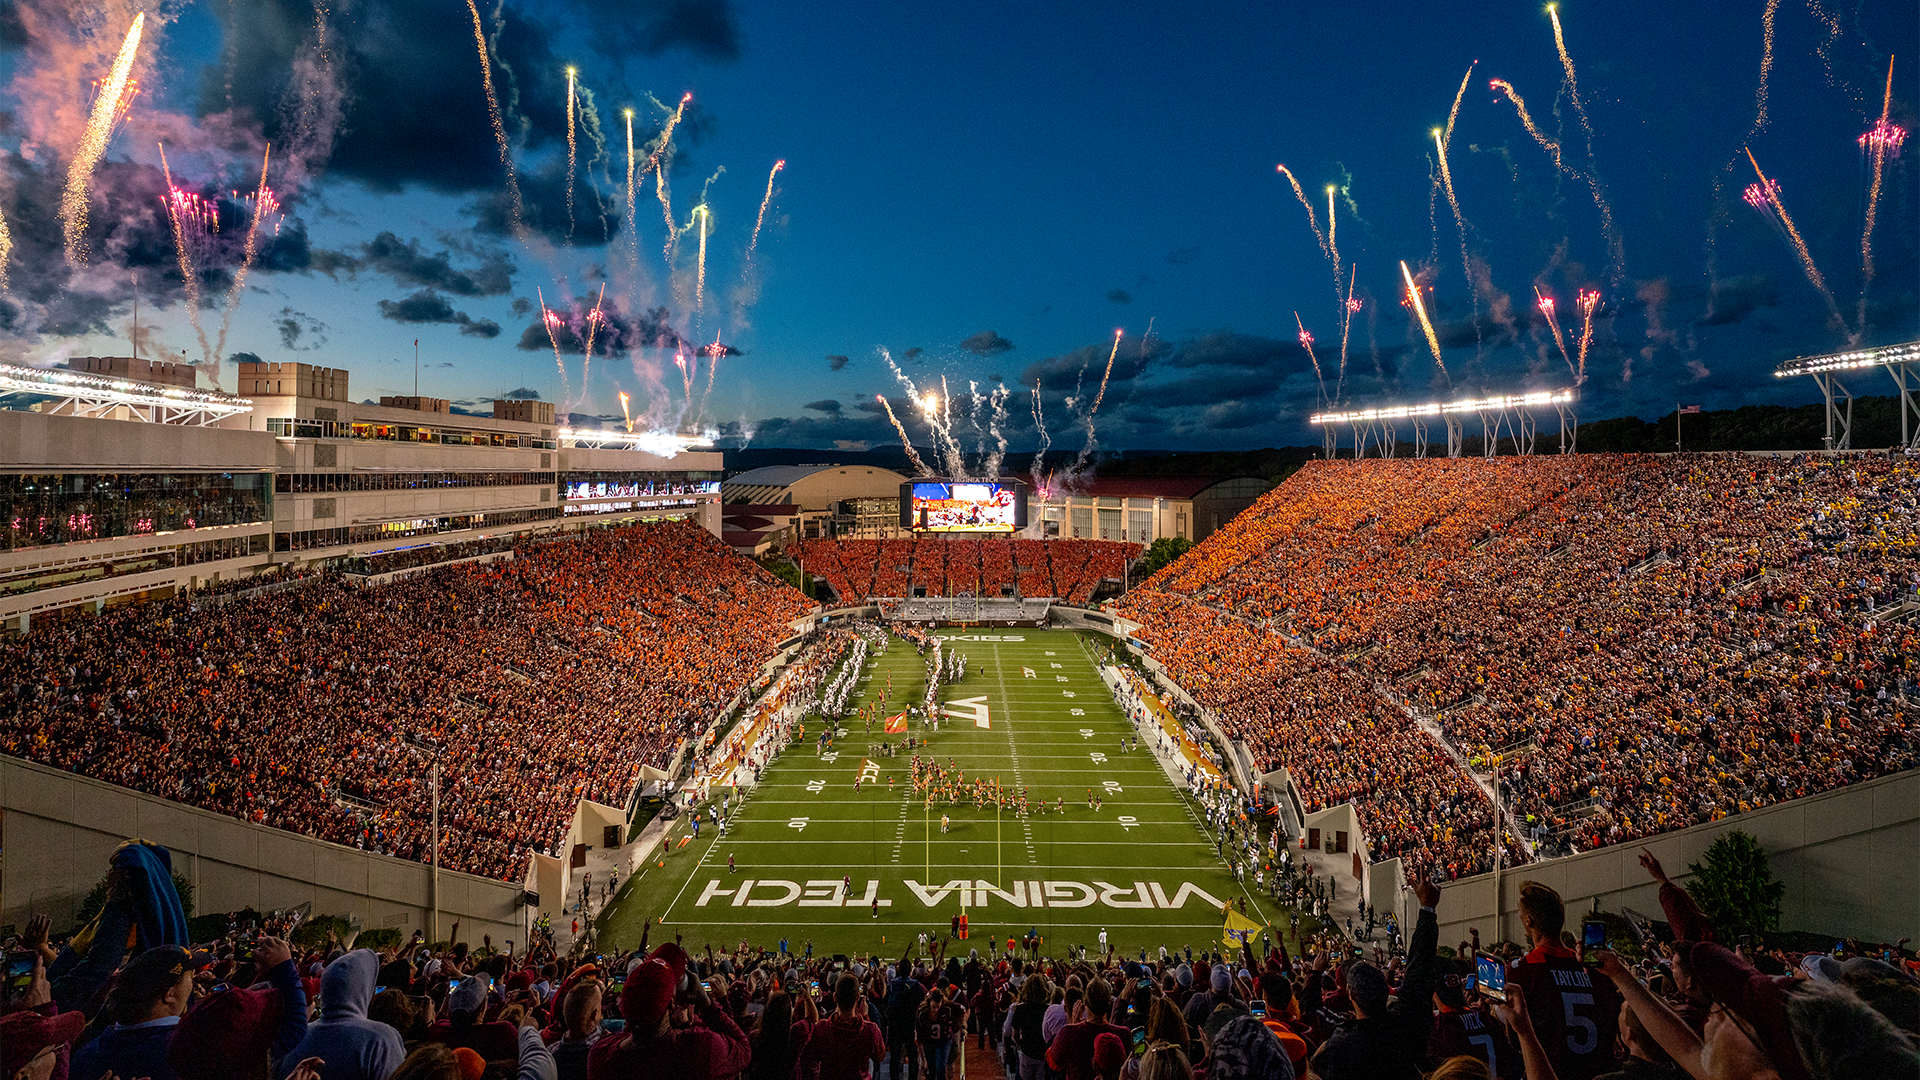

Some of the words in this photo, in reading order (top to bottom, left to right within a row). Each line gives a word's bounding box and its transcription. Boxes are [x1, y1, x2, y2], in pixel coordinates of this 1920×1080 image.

[939, 695, 992, 730] VT
[1090, 752, 1108, 763] 30
[860, 758, 881, 785] ACC
[806, 780, 826, 791] 20
[1102, 781, 1123, 792] 20
[788, 817, 809, 828] 10
[1118, 816, 1140, 827] 10
[694, 879, 893, 907] TECH
[902, 879, 1225, 909] VIRGINIA
[1550, 969, 1593, 988] TAYLOR
[1459, 1012, 1486, 1031] VICK
[1561, 991, 1598, 1055] 5
[930, 1023, 941, 1040] 3
[1468, 1033, 1498, 1080] 7
